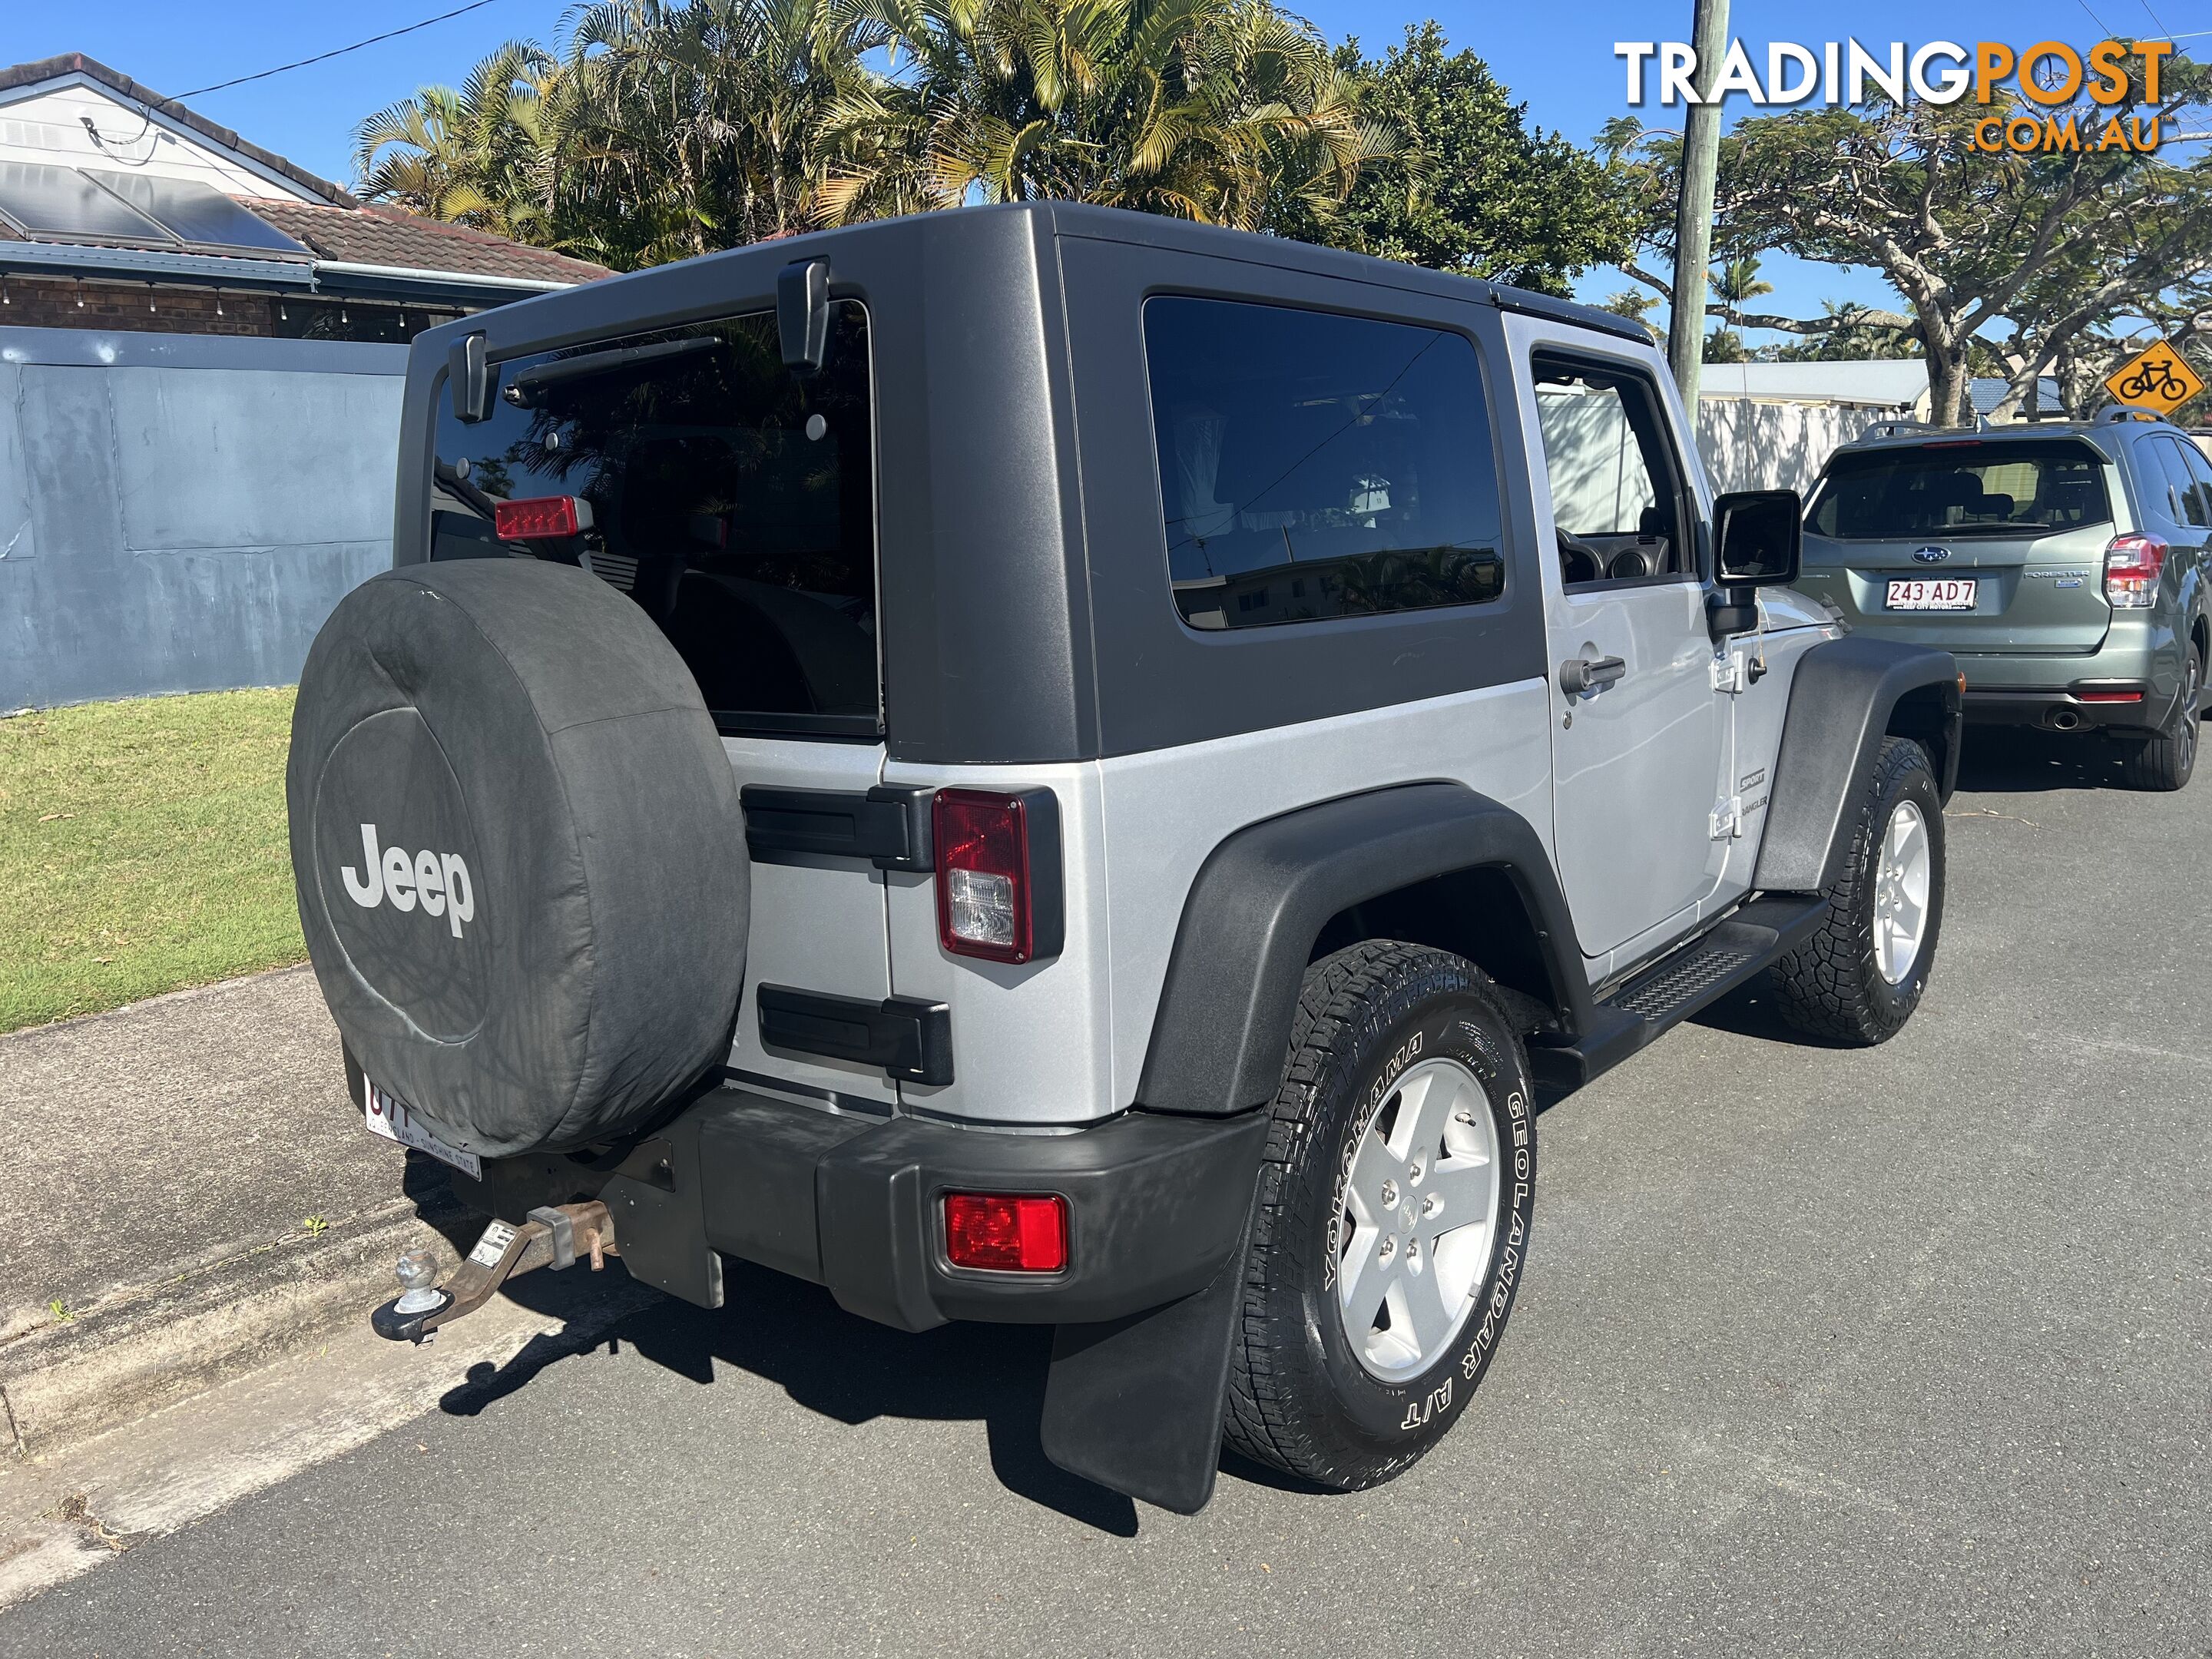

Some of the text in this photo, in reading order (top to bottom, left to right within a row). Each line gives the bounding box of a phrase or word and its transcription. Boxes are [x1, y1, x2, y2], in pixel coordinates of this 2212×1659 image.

[2023, 570, 2090, 579] FORESTER
[1740, 770, 1765, 790] SPORT
[1741, 795, 1768, 816] RANGLER
[340, 823, 475, 939] Jeep
[420, 1138, 454, 1161] SUNSHINE
[455, 1154, 475, 1173] STATE
[1325, 1031, 1422, 1292] YOKOHAMA
[1462, 1091, 1530, 1380] GEOLANDAR
[1400, 1376, 1453, 1430] A/T
